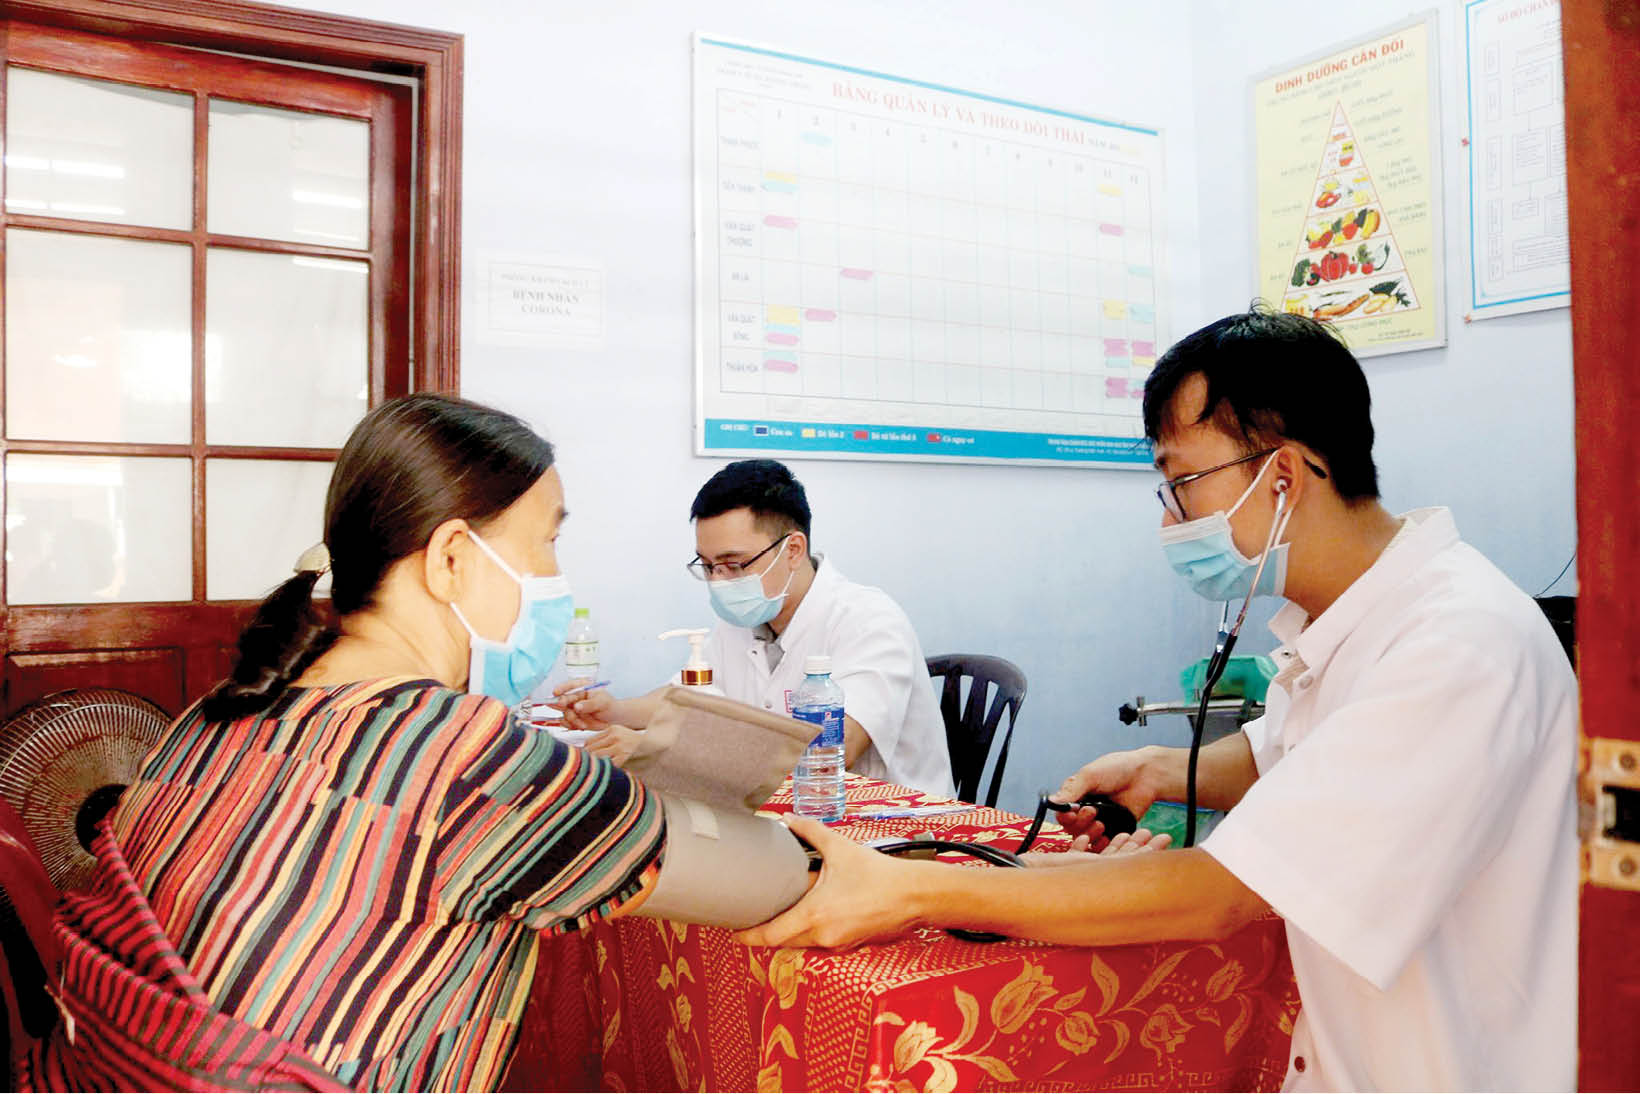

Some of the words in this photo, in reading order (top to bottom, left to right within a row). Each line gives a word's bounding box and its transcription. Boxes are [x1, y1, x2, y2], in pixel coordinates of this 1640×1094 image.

[832, 79, 877, 104] BẢNG
[883, 88, 927, 113] QUẢN
[981, 111, 1020, 130] THEO
